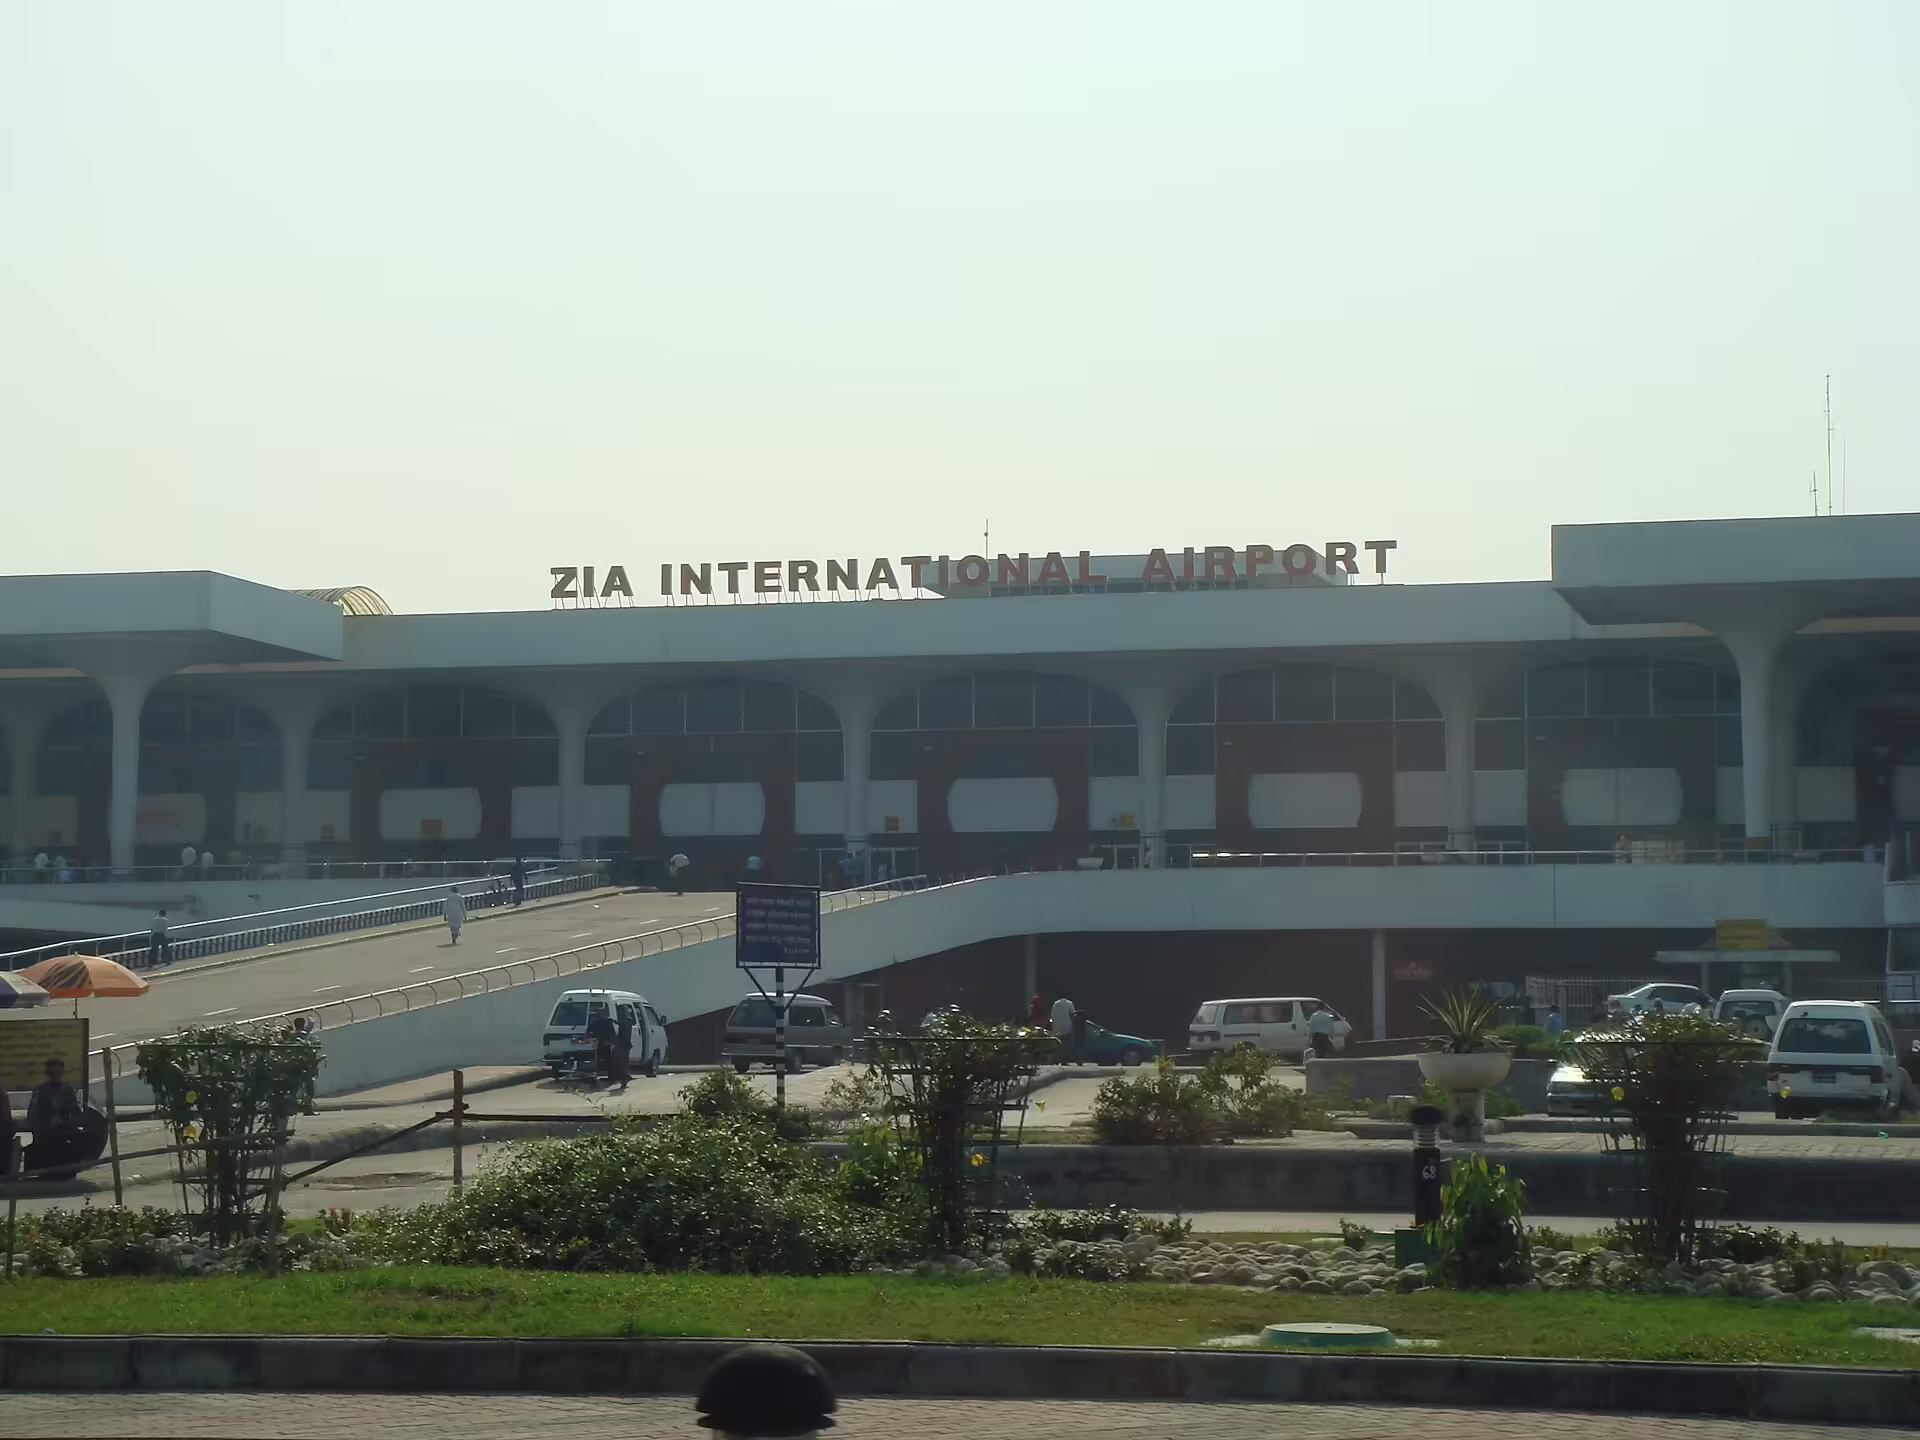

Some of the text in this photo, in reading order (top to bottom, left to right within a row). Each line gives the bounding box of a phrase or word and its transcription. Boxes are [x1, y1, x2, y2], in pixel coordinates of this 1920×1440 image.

[550, 540, 1397, 598] ZIA INTERNATIONAL AIRPORT
